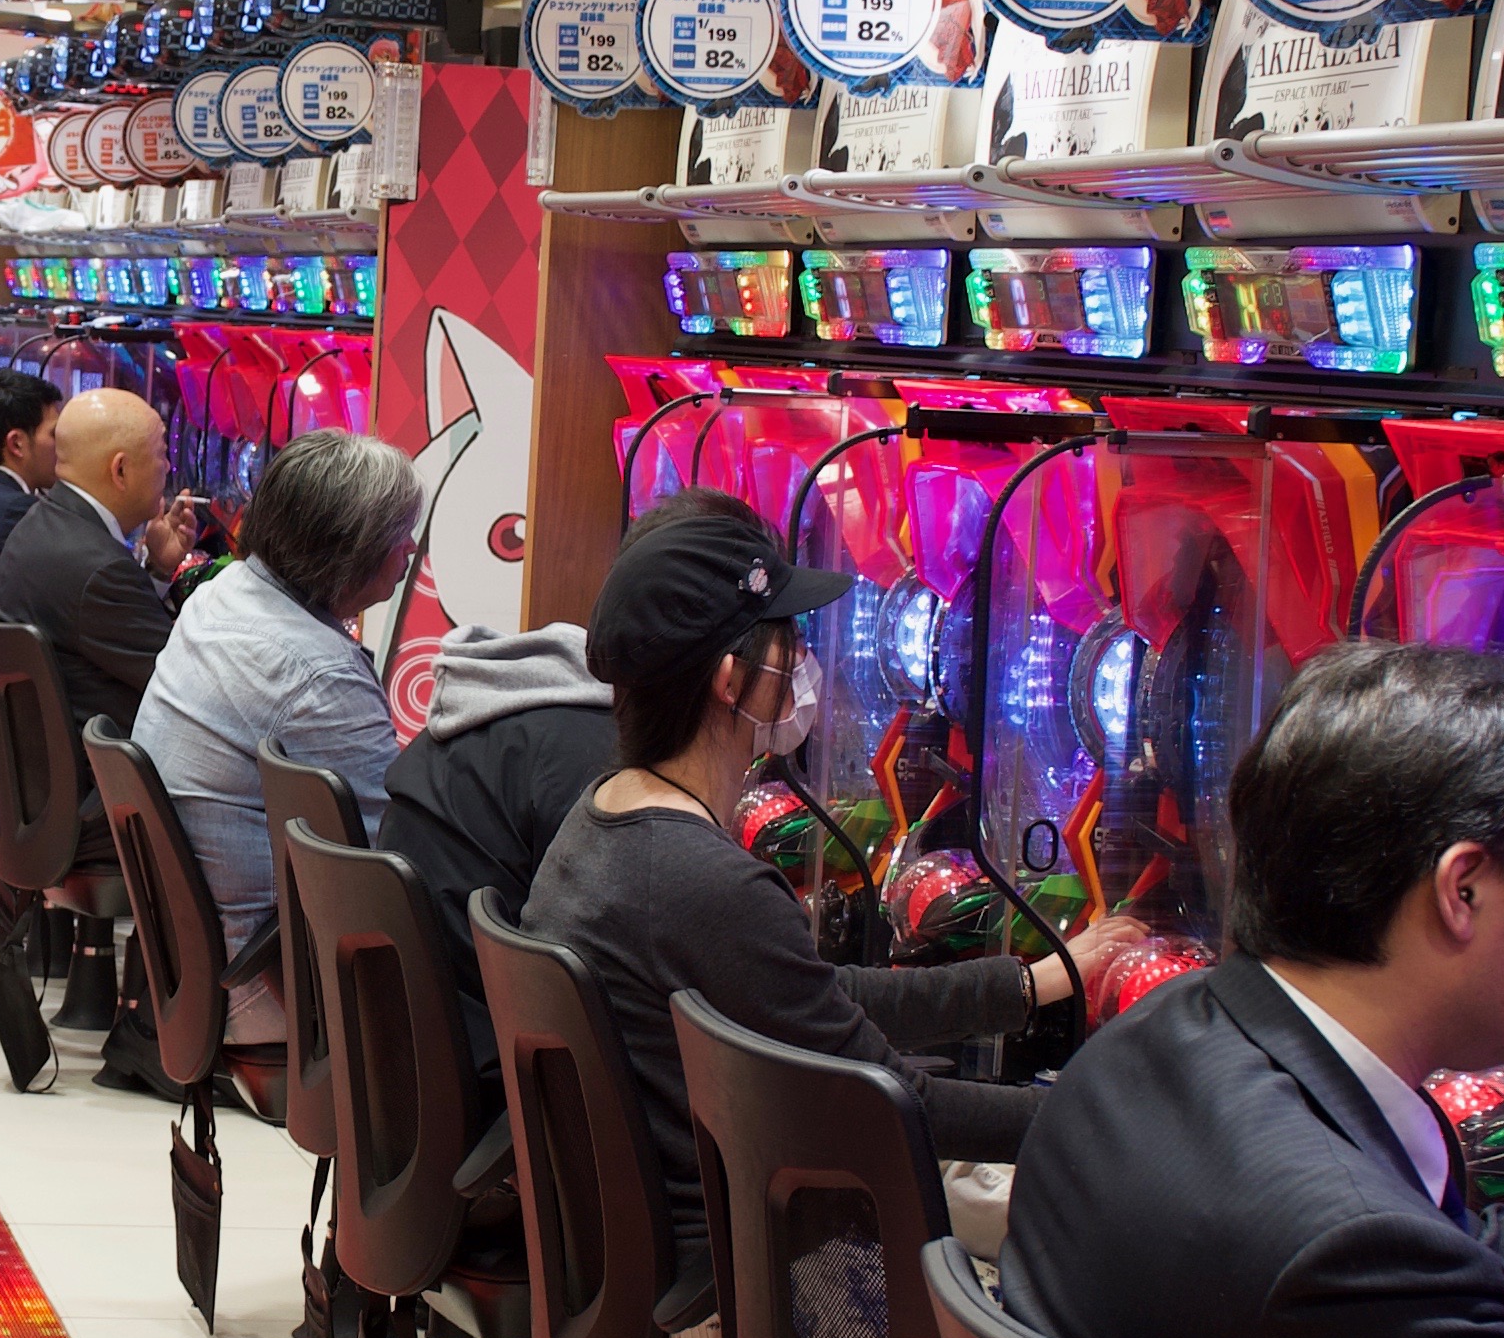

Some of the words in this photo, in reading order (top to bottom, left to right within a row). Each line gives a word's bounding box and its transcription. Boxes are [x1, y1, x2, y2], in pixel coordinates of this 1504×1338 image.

[858, 20, 903, 42] 82%
[587, 54, 624, 72] 82%
[705, 50, 746, 70] 82%
[1016, 60, 1132, 102] AKIHABARA
[1273, 88, 1307, 102] ESPACE
[1309, 81, 1350, 99] NITTAKU
[325, 105, 354, 120] 82%
[840, 86, 930, 119] AKIHABARA
